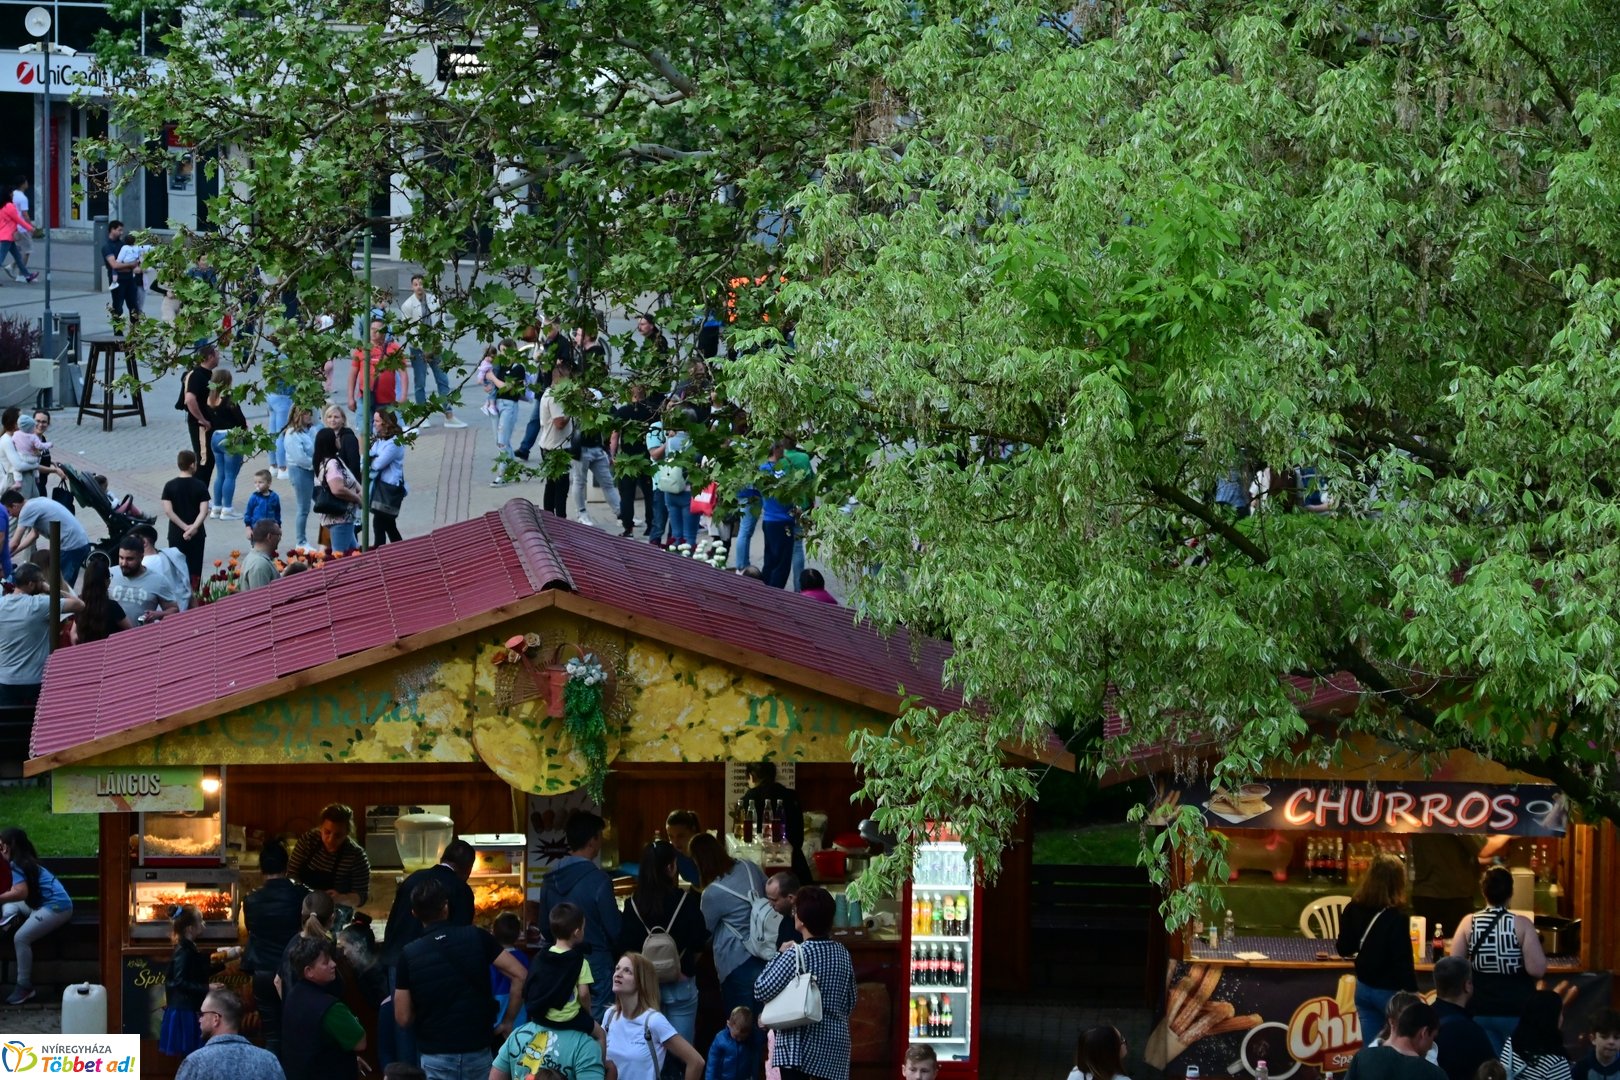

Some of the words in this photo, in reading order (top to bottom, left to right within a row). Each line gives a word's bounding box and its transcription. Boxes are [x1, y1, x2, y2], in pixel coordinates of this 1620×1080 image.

[112, 585, 148, 605] GAP
[96, 770, 161, 796] LÁNGOS
[1283, 787, 1520, 831] CHURROS
[134, 968, 167, 989] Spir
[1289, 999, 1363, 1058] Chu
